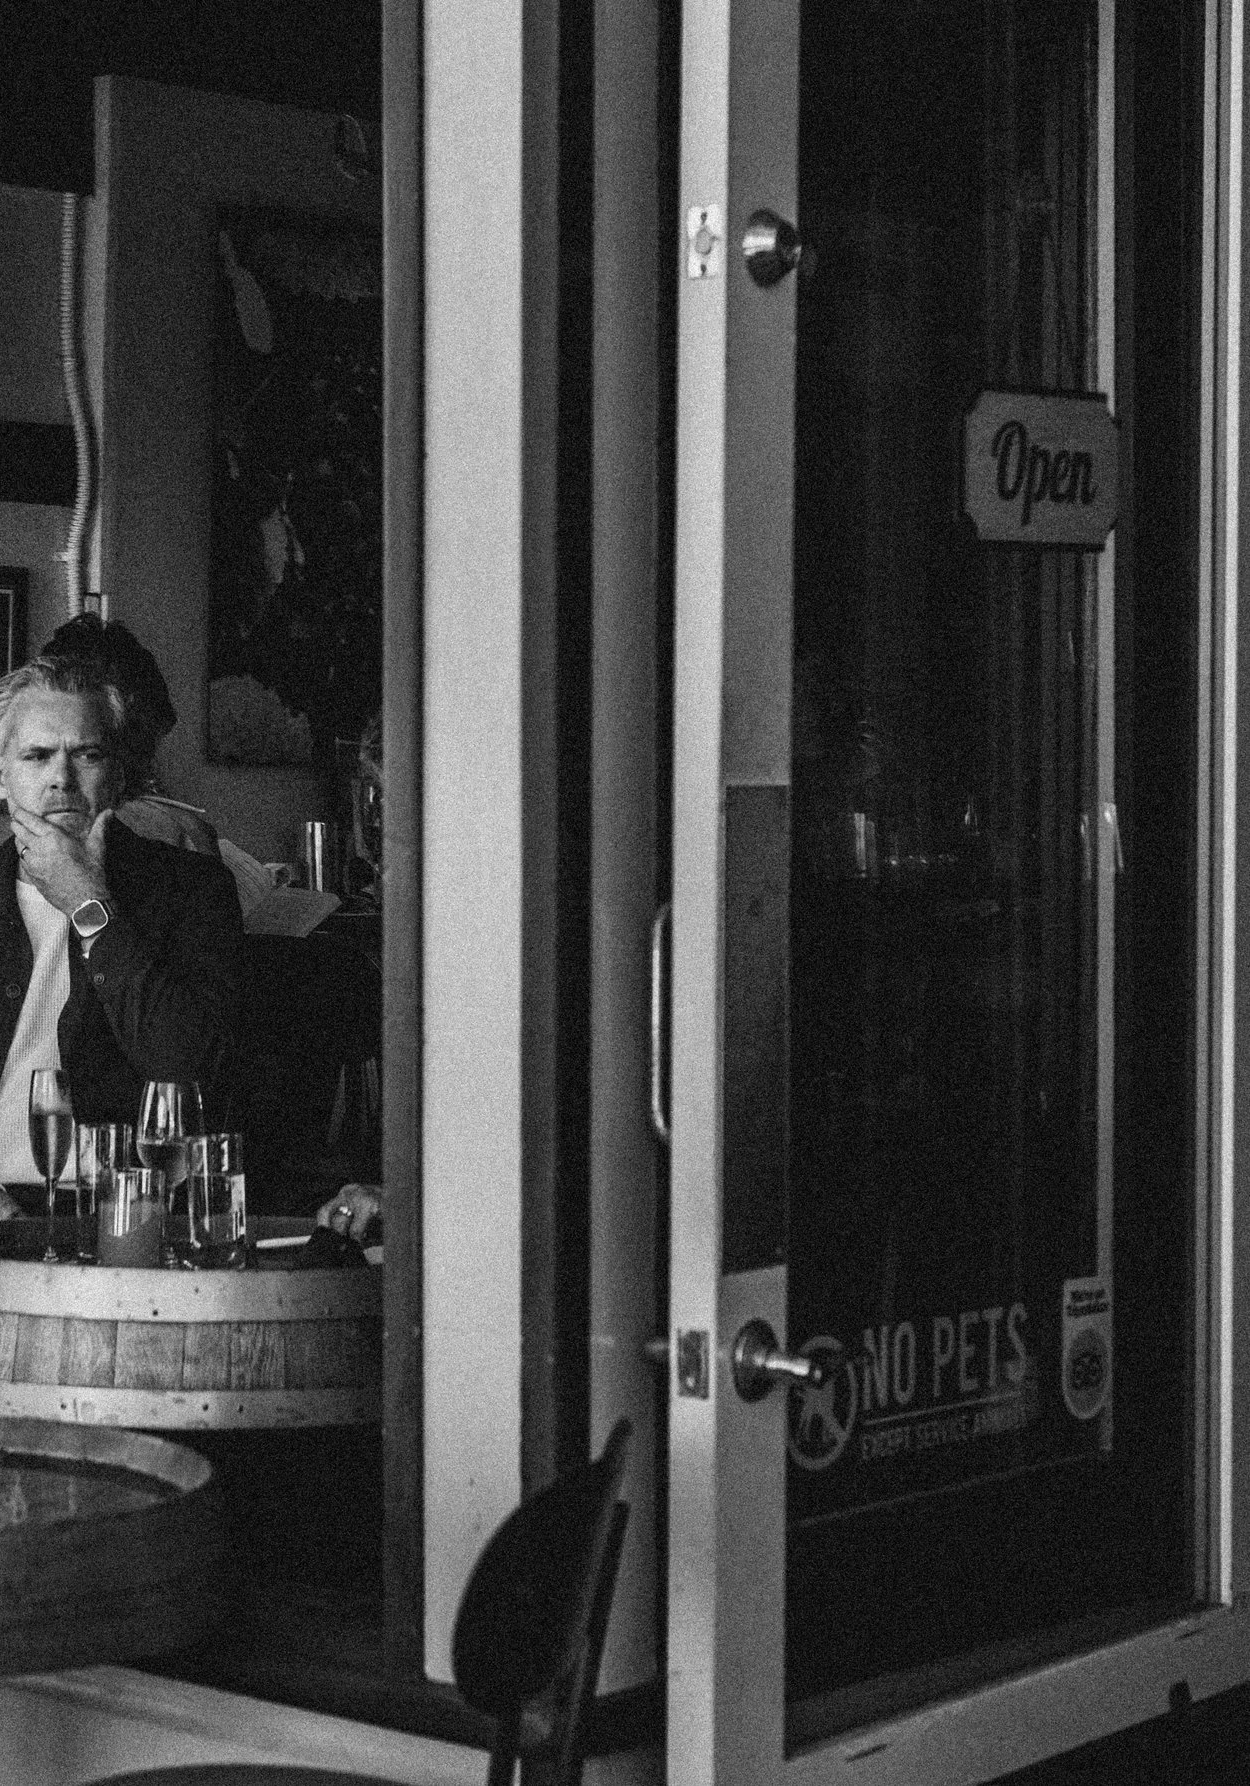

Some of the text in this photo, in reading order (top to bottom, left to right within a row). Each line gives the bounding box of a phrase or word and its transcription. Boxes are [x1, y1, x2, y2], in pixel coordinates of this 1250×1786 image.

[991, 420, 1099, 527] Open
[861, 1301, 1030, 1412] NO PETS
